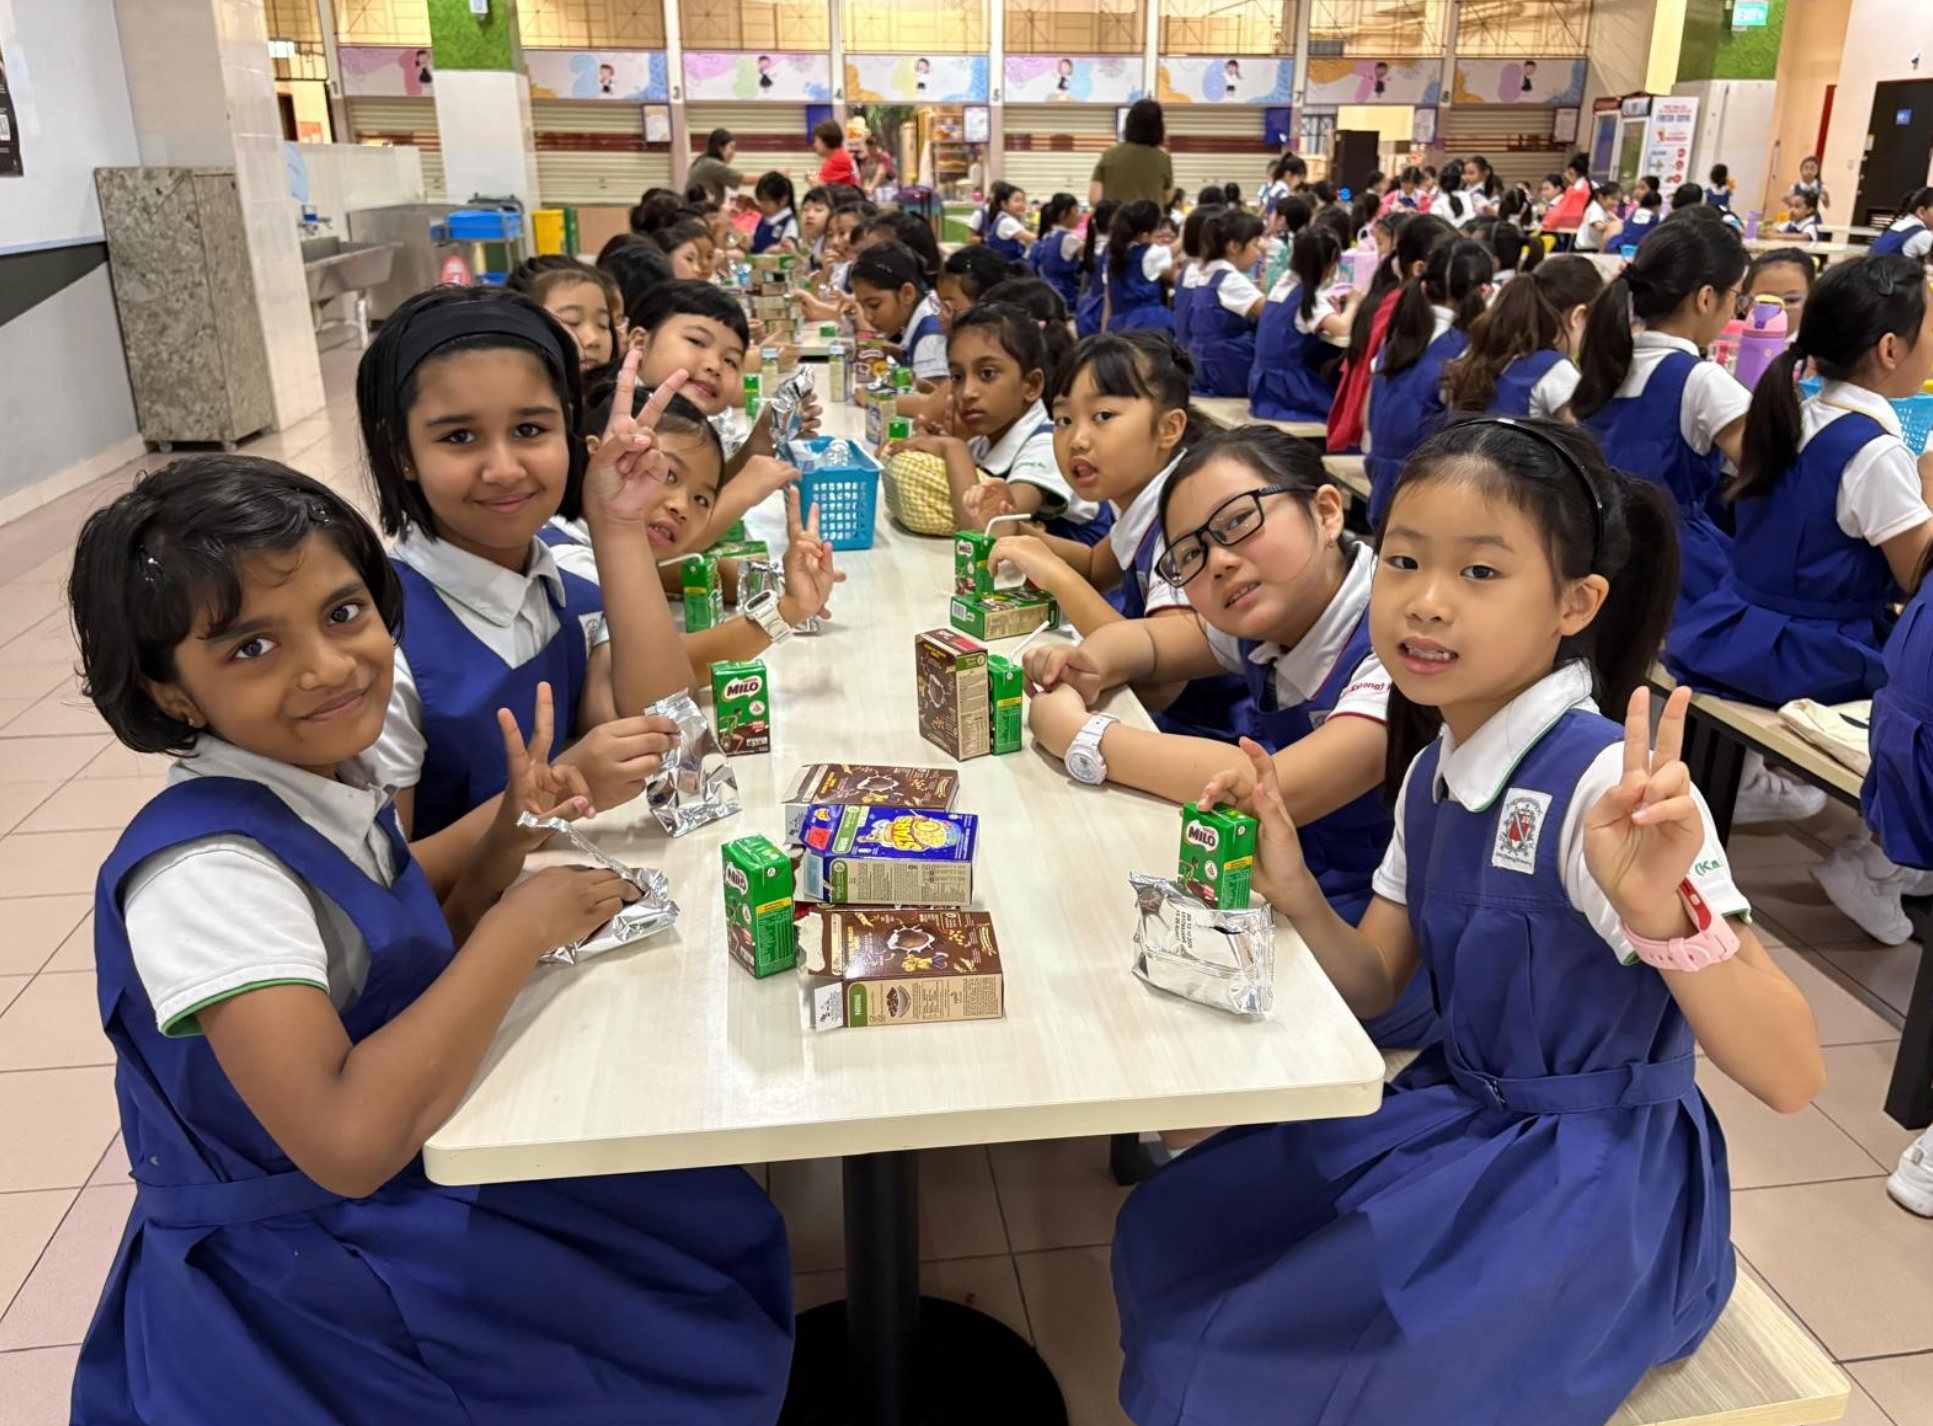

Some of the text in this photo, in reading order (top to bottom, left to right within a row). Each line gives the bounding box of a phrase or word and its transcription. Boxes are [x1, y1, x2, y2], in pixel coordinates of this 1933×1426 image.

[673, 85, 681, 100] 3
[727, 681, 759, 697] MILO
[893, 816, 923, 851] STARS
[1188, 825, 1216, 848] MILO
